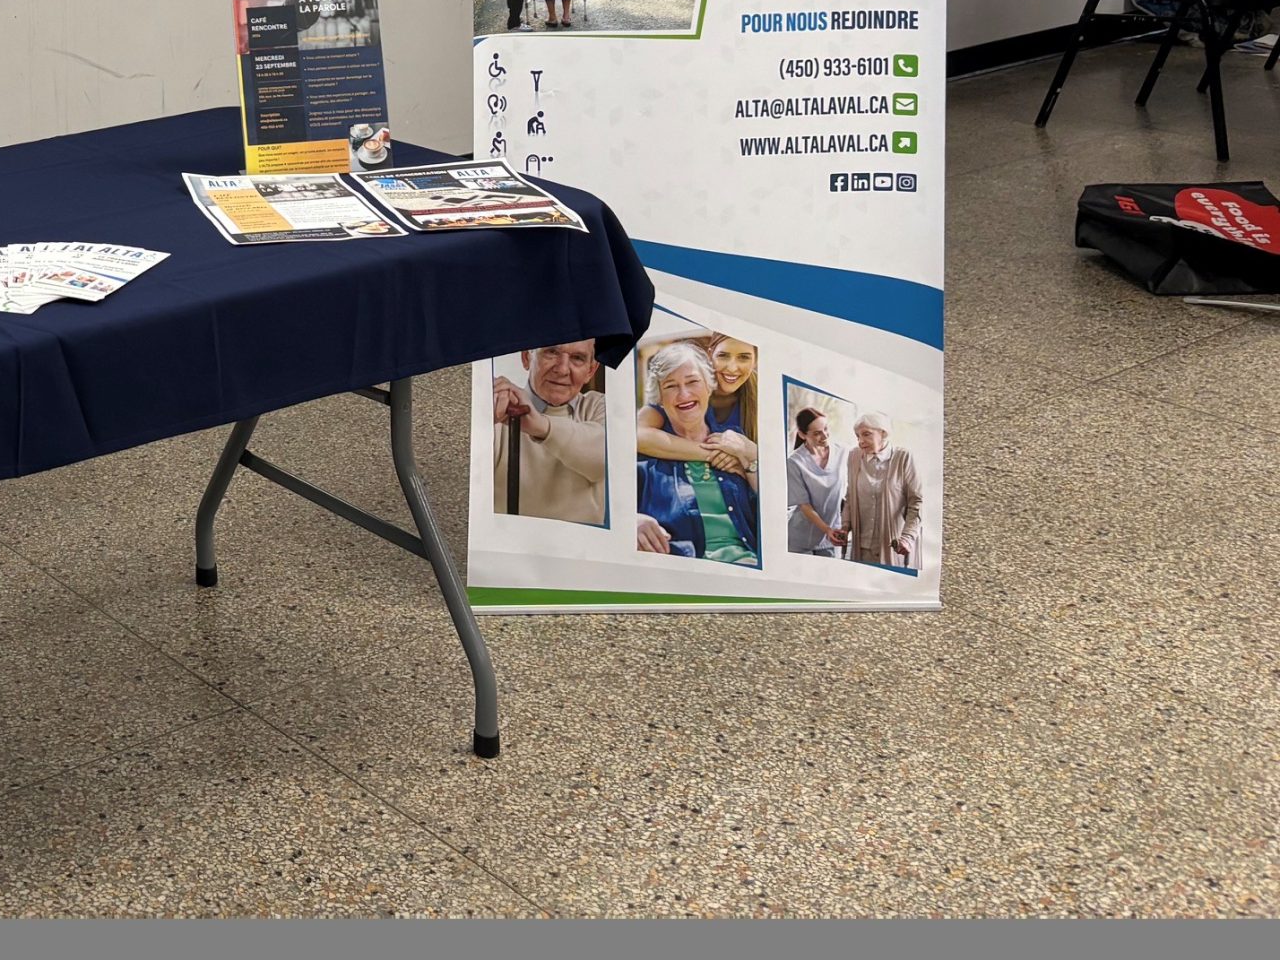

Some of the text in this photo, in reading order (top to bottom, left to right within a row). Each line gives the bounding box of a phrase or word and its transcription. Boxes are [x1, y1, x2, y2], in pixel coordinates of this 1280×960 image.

[299, 2, 347, 14] LA PAROLE
[250, 16, 267, 24] CAFÉ
[740, 10, 919, 33] POUR NOUS REJOINDRE
[251, 23, 288, 32] RENCONTRE
[254, 54, 285, 62] MERCREDI
[263, 61, 297, 69] SEPTEMBRE
[779, 56, 889, 81] (450) 933-6101
[735, 95, 889, 120] ALTA@ALTALAVAL.CA
[739, 134, 889, 156] WWW.ALTALAVAL.CA
[456, 168, 490, 177] ALTA
[207, 180, 237, 188] ALTA
[1220, 201, 1272, 244] Food is
[98, 246, 144, 259] ALTA
